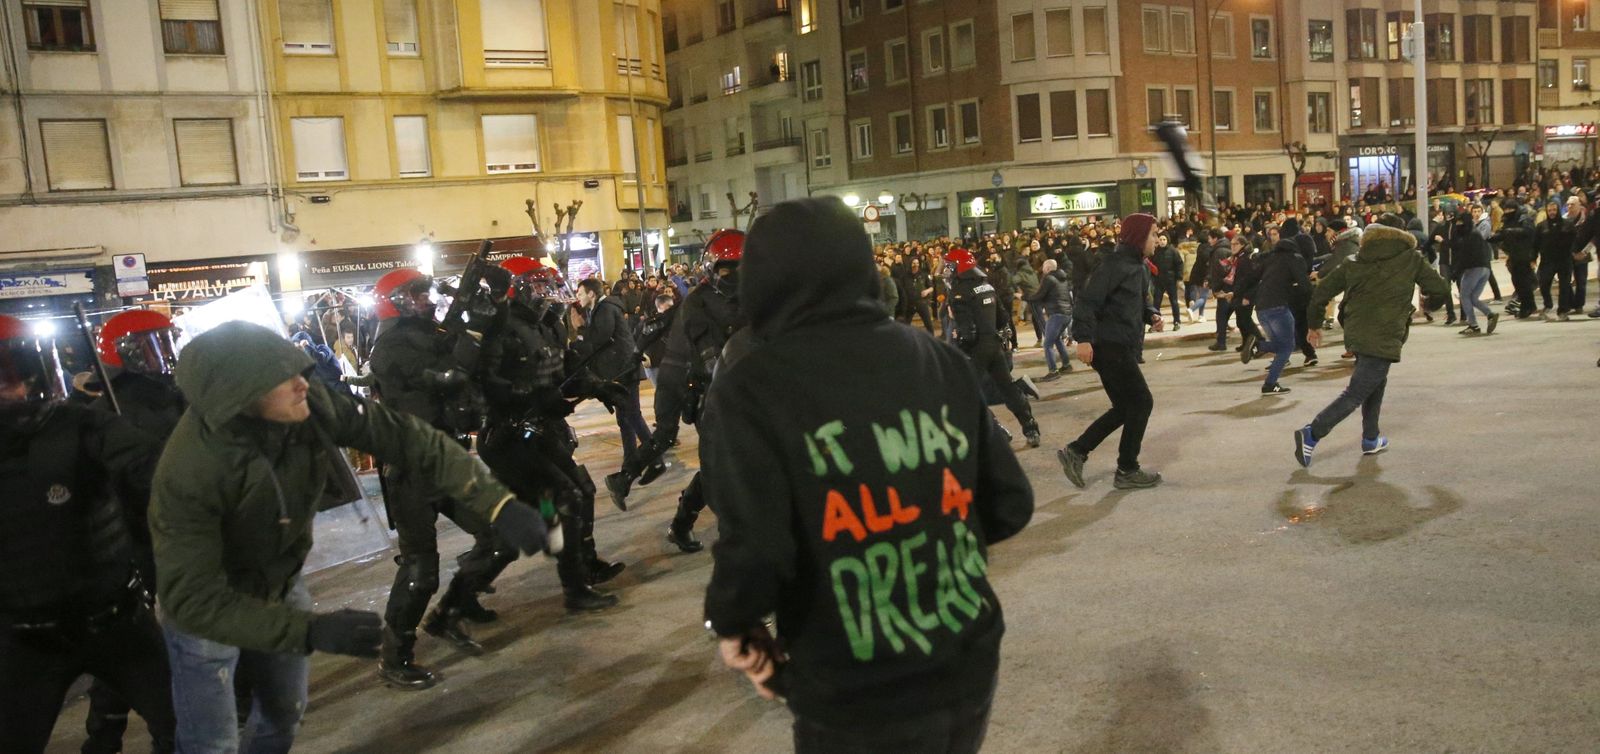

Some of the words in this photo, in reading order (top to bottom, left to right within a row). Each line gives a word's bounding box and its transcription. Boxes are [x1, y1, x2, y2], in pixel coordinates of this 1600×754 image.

[1065, 198, 1103, 210] STADIUM
[311, 266, 331, 274] Peña
[332, 264, 366, 273] EUSKAL
[367, 261, 394, 270] LIONS
[152, 289, 177, 302] LA
[804, 420, 854, 476] IT
[872, 404, 969, 474] WAS
[821, 483, 922, 542] ALL
[941, 467, 973, 521] A
[829, 521, 988, 661] DREAM
